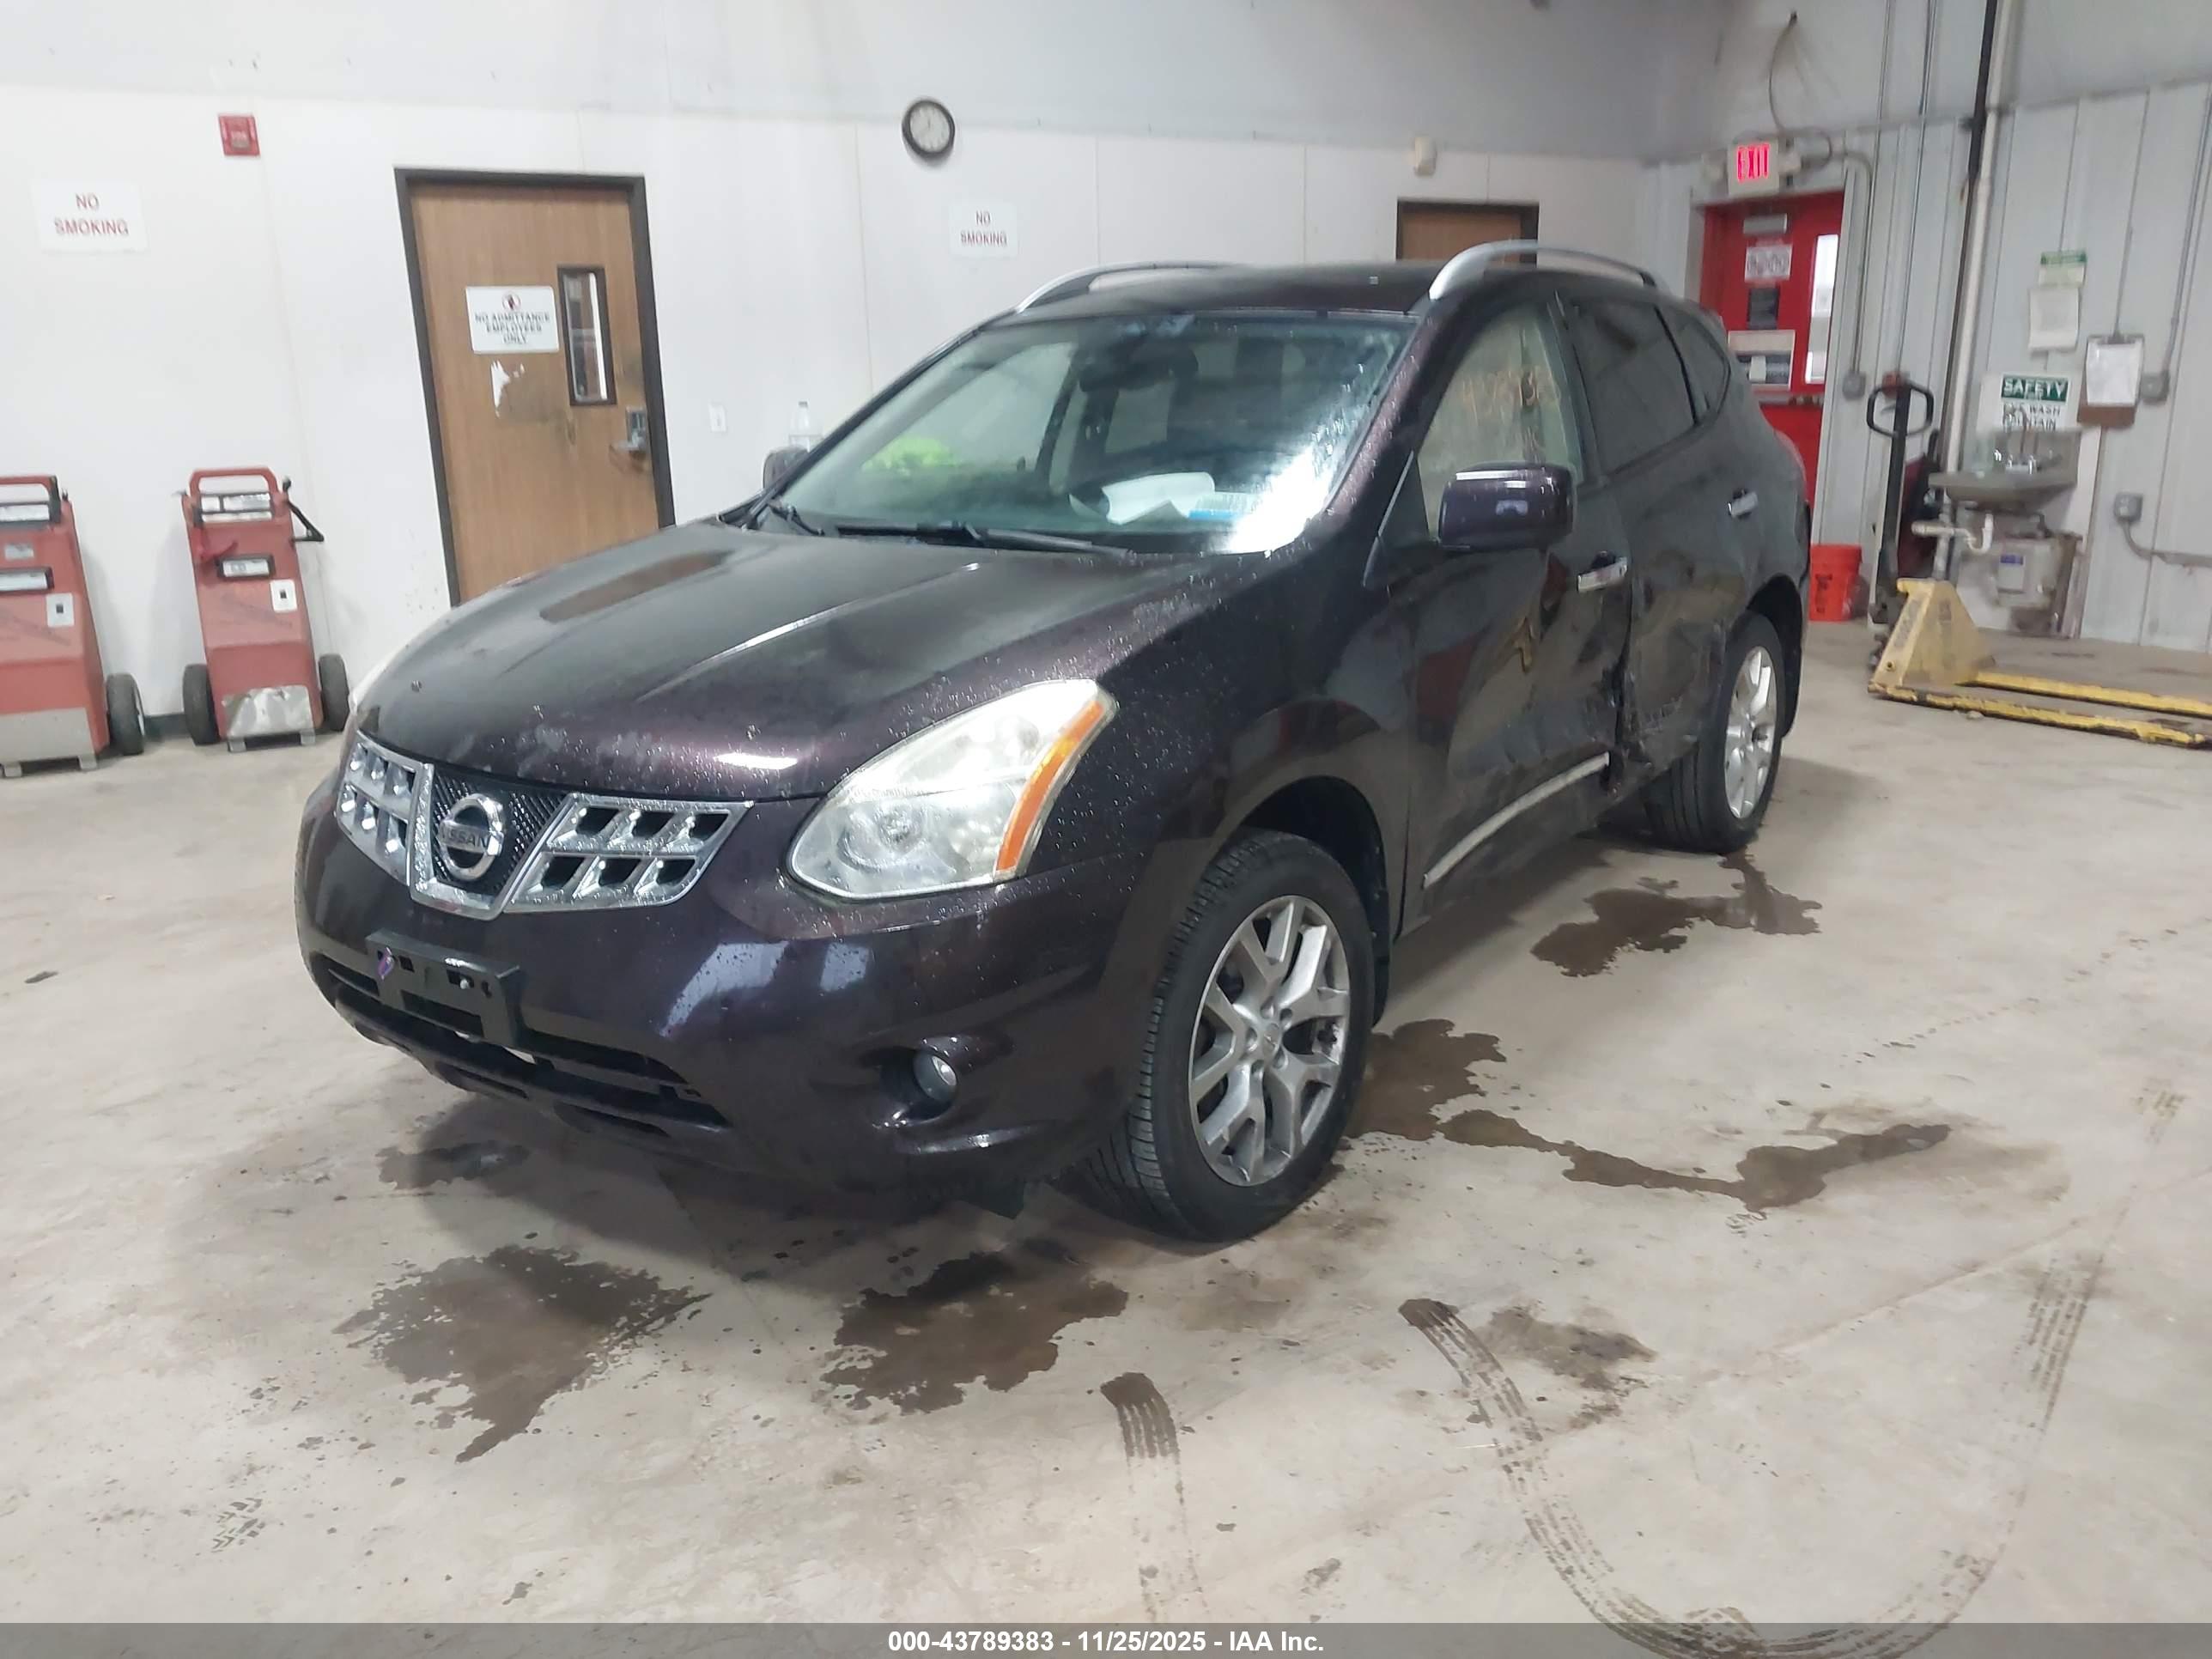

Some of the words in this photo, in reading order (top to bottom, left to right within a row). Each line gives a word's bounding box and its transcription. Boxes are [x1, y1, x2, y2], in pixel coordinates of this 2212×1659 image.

[1736, 143, 1770, 182] EXIT
[75, 193, 100, 210] NO
[975, 210, 991, 225] NO
[53, 218, 130, 236] SMOKING
[961, 232, 1007, 247] SMOKING
[474, 312, 489, 323] NO
[492, 312, 550, 323] ADMITTANCE
[486, 323, 543, 333] EMPLOYEES
[503, 334, 527, 344] ONLY
[2002, 376, 2067, 399] SAFETY
[2029, 403, 2062, 416] WASH
[441, 823, 490, 848] NISSAN
